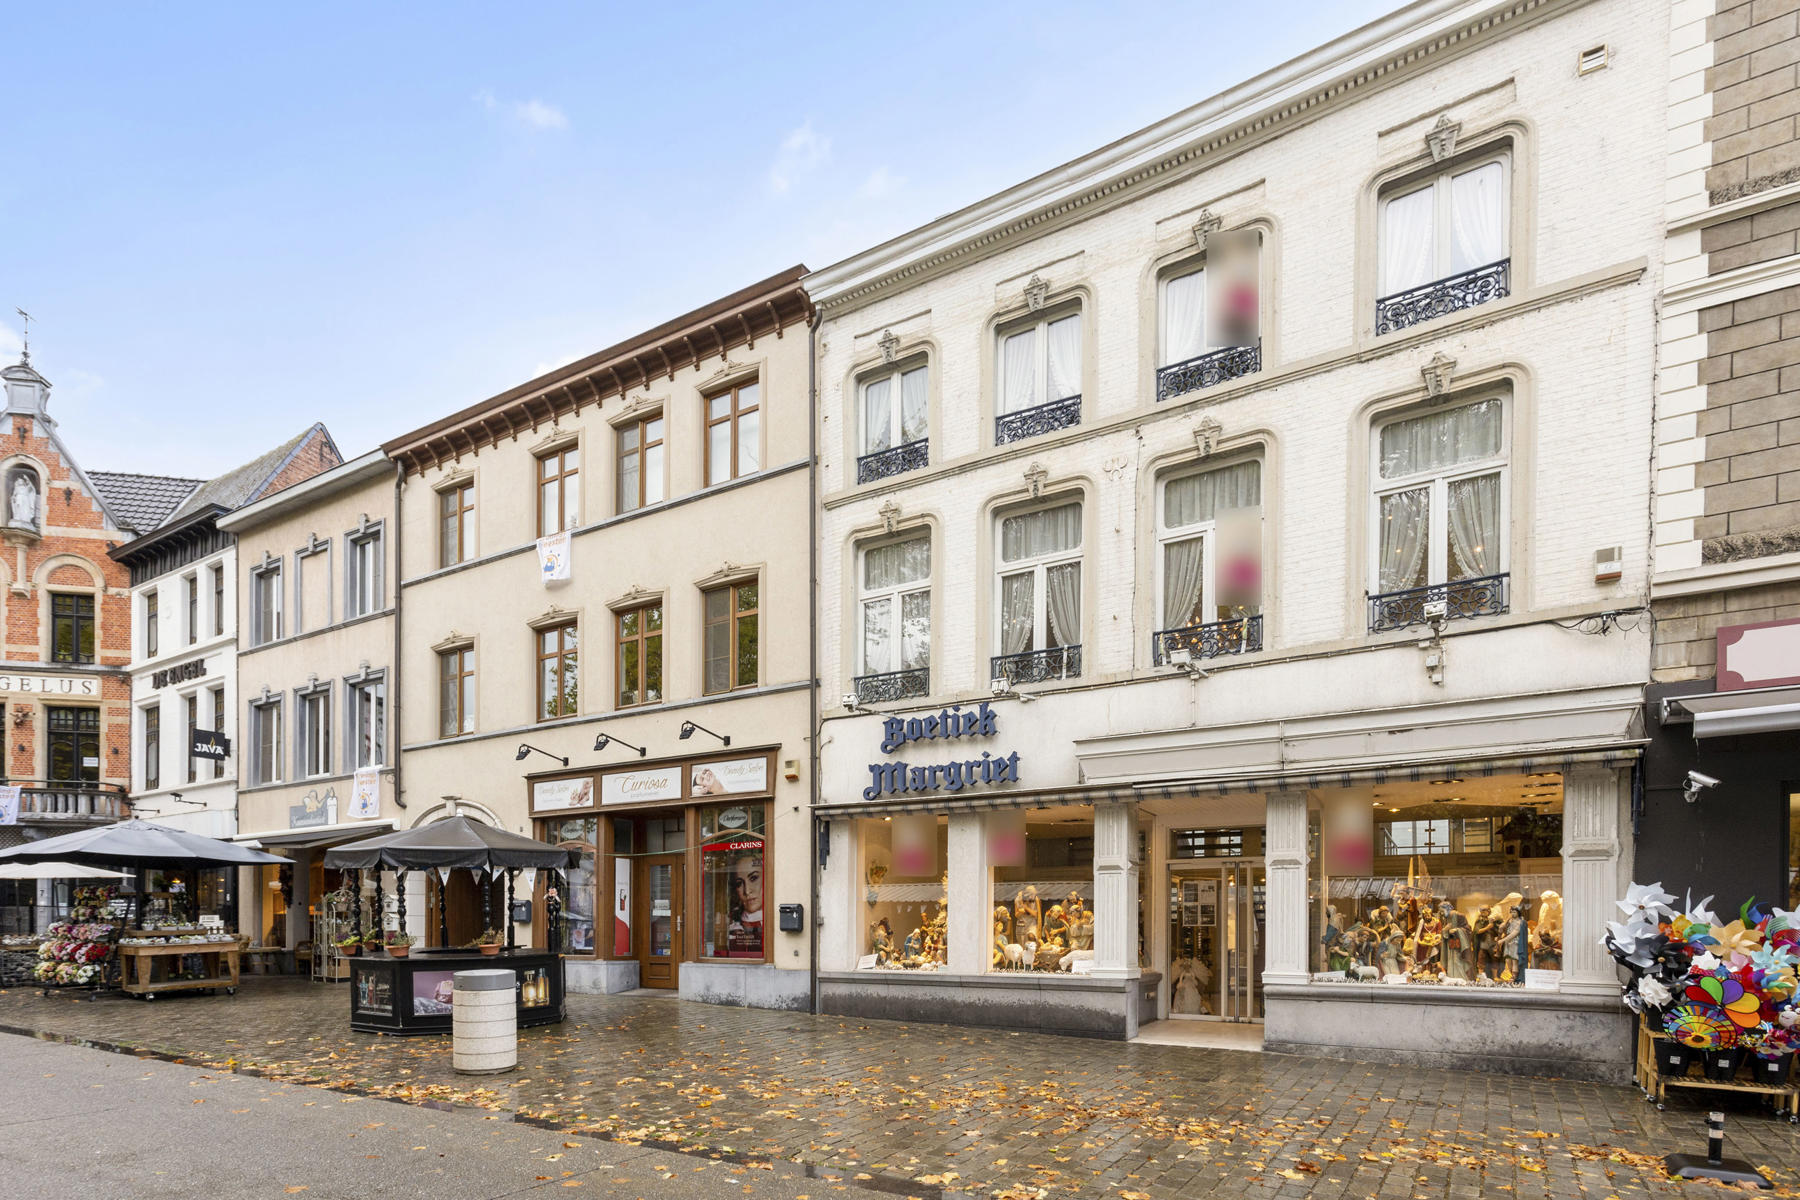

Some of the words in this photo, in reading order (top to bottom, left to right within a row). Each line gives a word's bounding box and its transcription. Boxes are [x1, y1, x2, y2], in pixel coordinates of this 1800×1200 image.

[880, 701, 999, 755] Boetiek
[194, 742, 225, 755] JAVA
[614, 774, 669, 794] Curiosa
[862, 750, 1022, 800] Margriet
[729, 841, 762, 850] CLARINS
